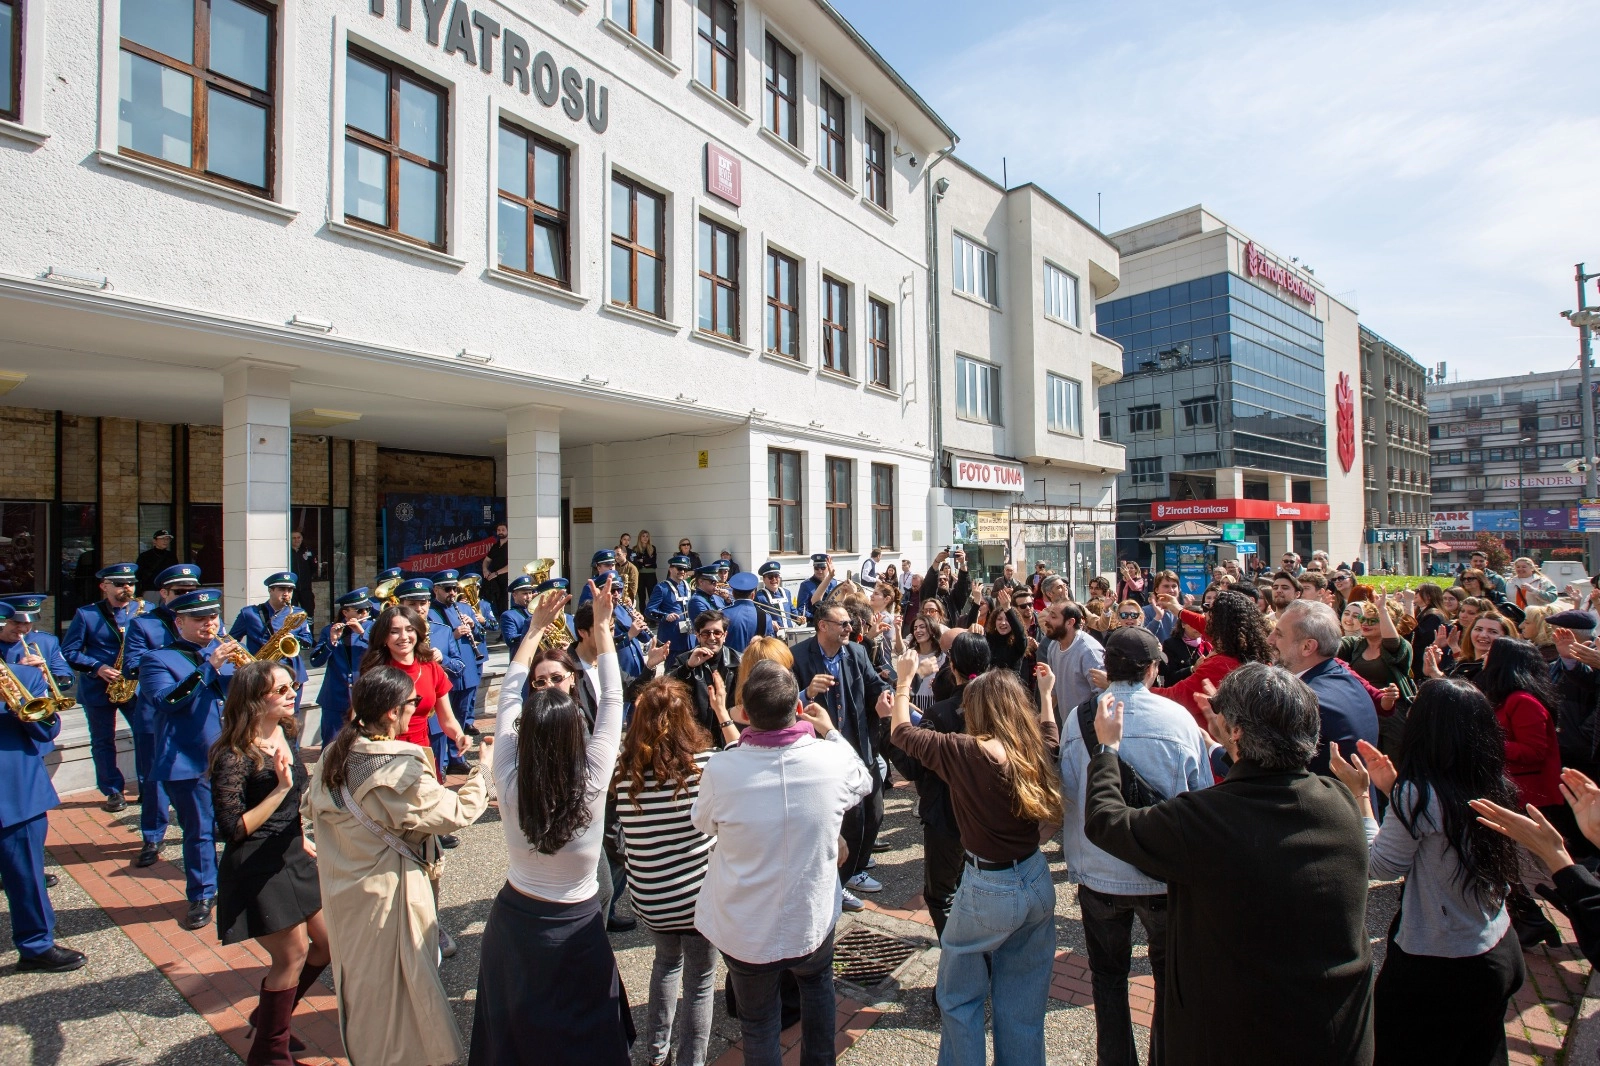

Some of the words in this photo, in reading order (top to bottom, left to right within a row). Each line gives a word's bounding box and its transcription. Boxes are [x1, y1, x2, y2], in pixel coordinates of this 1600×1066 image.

[369, 0, 609, 134] YATROSU
[1258, 252, 1288, 288] Ziraat
[958, 462, 991, 482] FOTO
[993, 466, 1022, 486] TUNA
[1504, 476, 1574, 488] İSKENDER
[1165, 506, 1193, 515] Ziraat
[1193, 505, 1229, 514] Bankası
[423, 536, 446, 550] Hadi
[411, 551, 457, 572] BİRLİKTE
